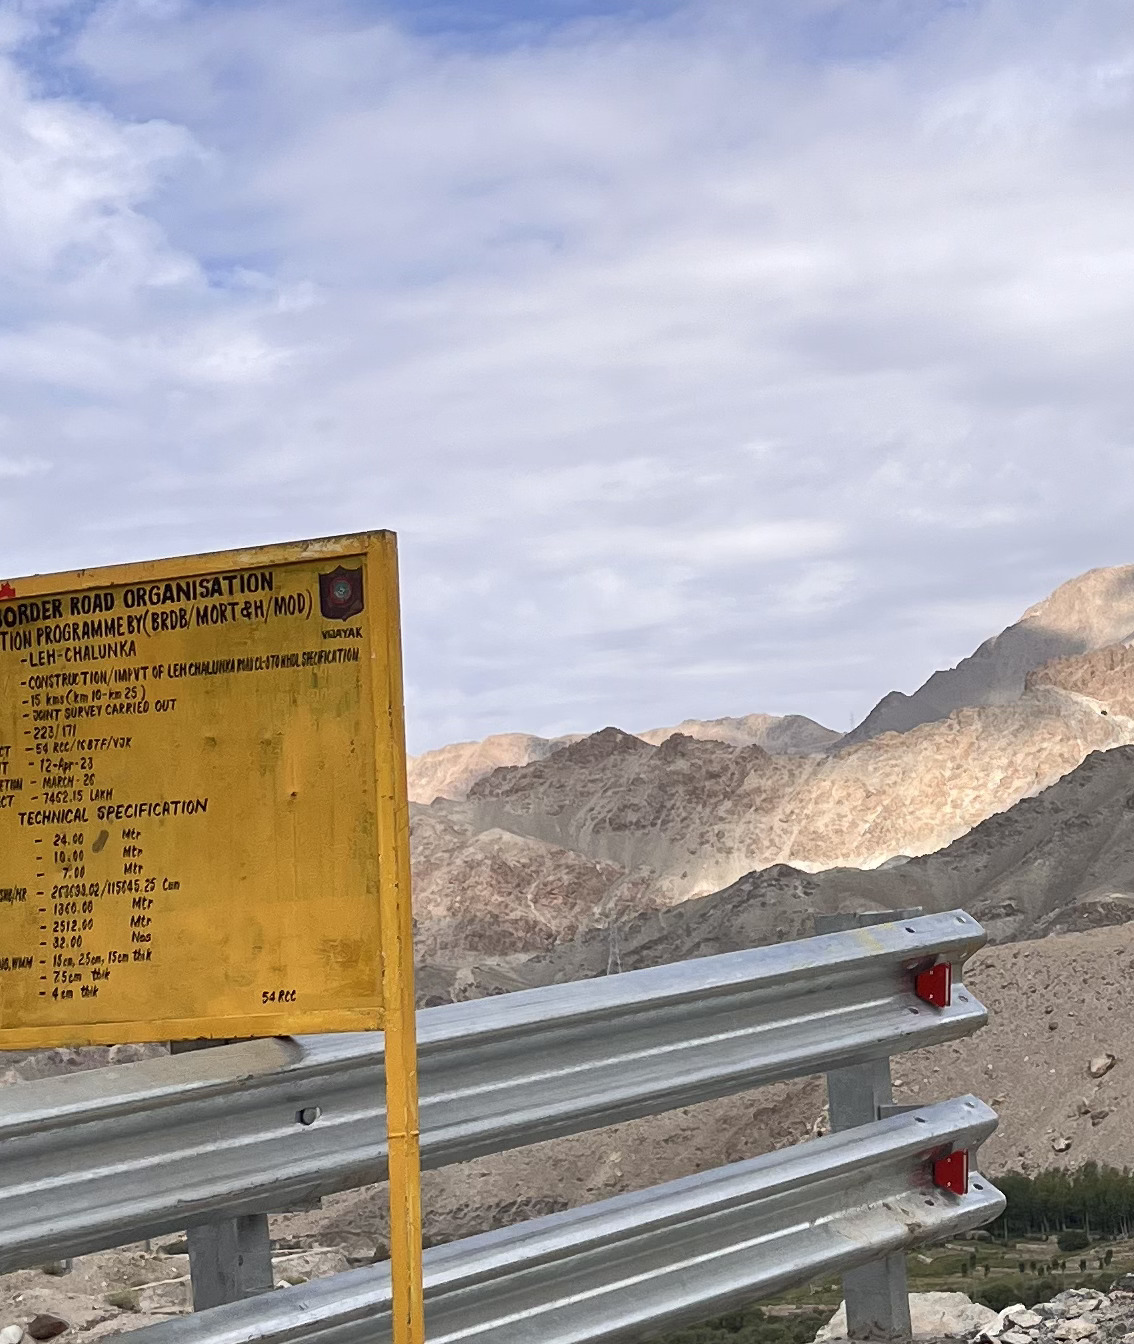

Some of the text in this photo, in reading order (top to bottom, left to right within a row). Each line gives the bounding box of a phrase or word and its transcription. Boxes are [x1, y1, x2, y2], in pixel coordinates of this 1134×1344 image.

[0, 571, 274, 628] ORDER ROAD ORGANISATION
[36, 616, 125, 647] PROGRAMME
[152, 664, 164, 680] OF
[64, 704, 102, 720] SURVEY
[105, 699, 150, 716] CARRIED
[154, 698, 177, 713] OUT
[89, 787, 114, 802] LAKH
[18, 797, 209, 827] TECHNICAL SPECIFICATION
[121, 828, 142, 840] Mtr
[122, 845, 144, 858] Mtr
[123, 862, 144, 875] Mtr
[131, 896, 154, 911] Mtr
[130, 914, 153, 928] Mtr
